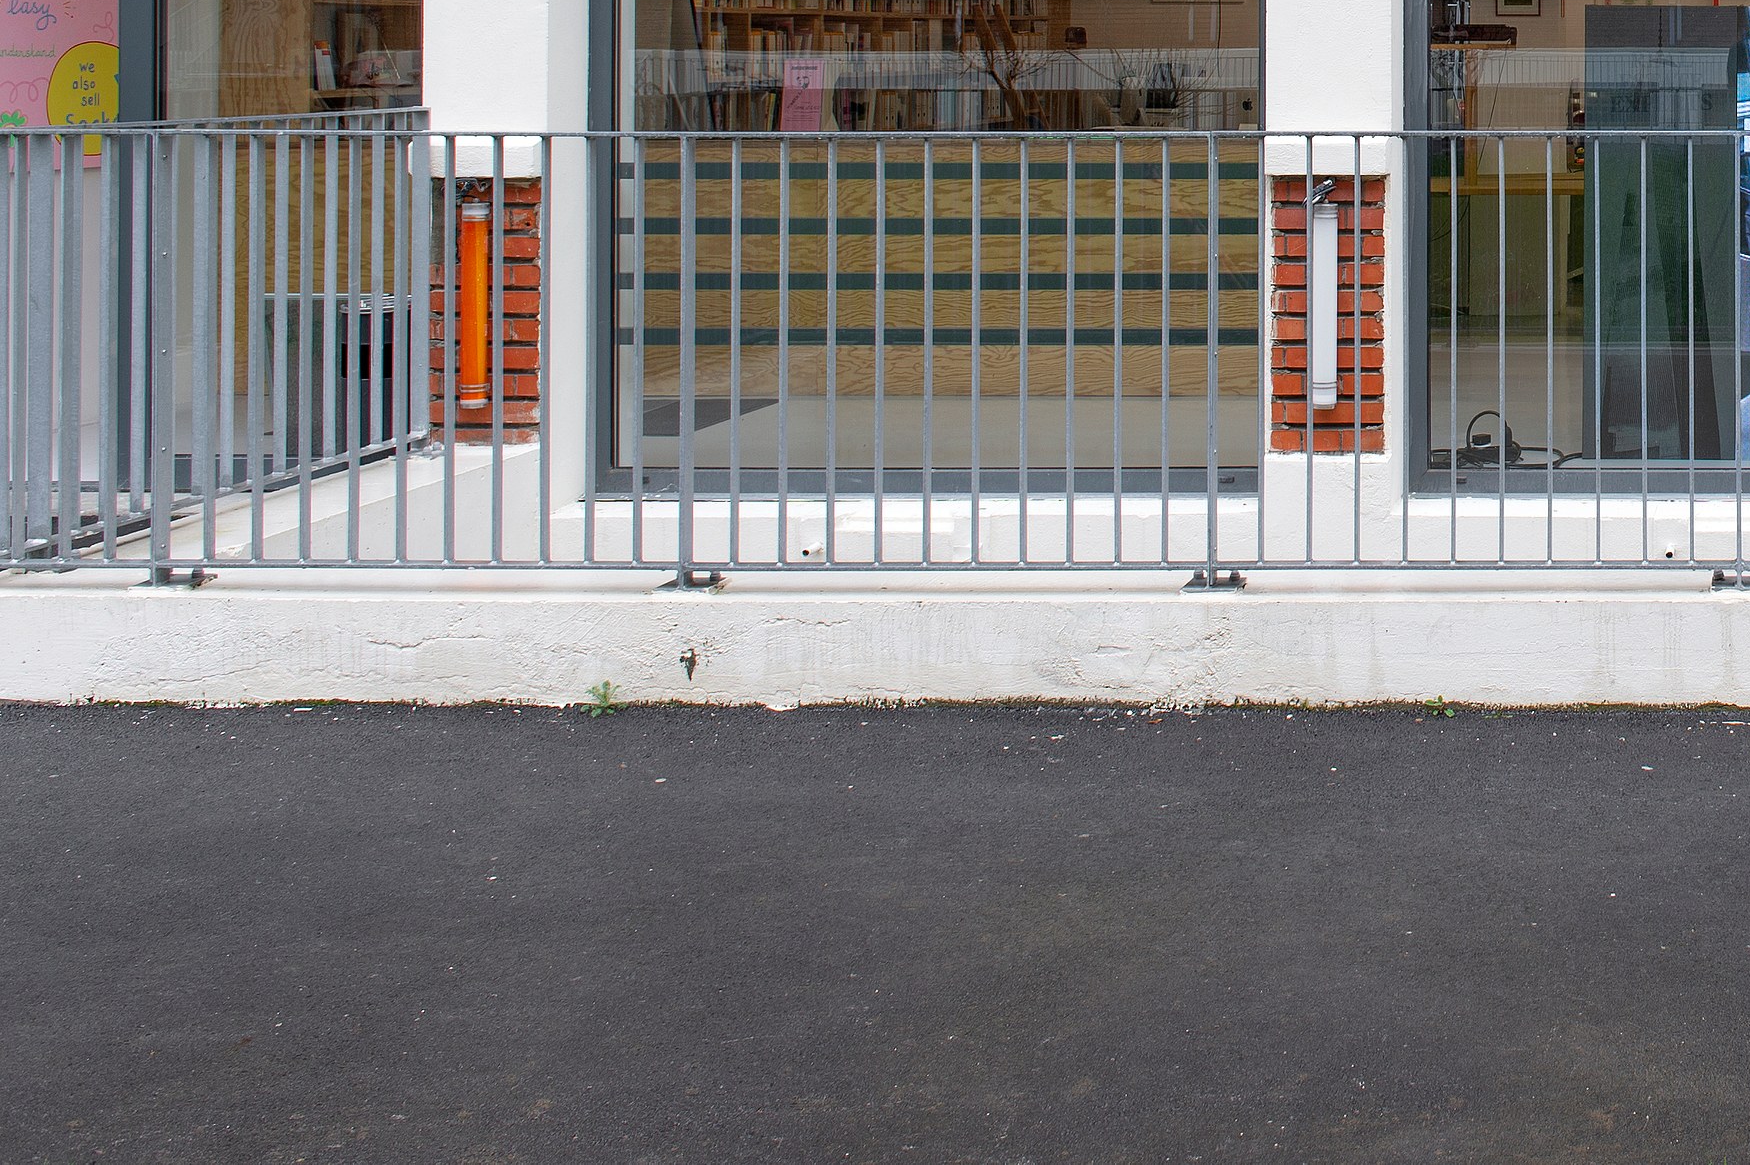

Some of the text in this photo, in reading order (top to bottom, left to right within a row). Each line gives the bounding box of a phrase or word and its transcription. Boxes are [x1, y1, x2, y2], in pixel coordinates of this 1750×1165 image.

[79, 62, 95, 73] we
[72, 76, 96, 91] also
[81, 93, 100, 106] sell
